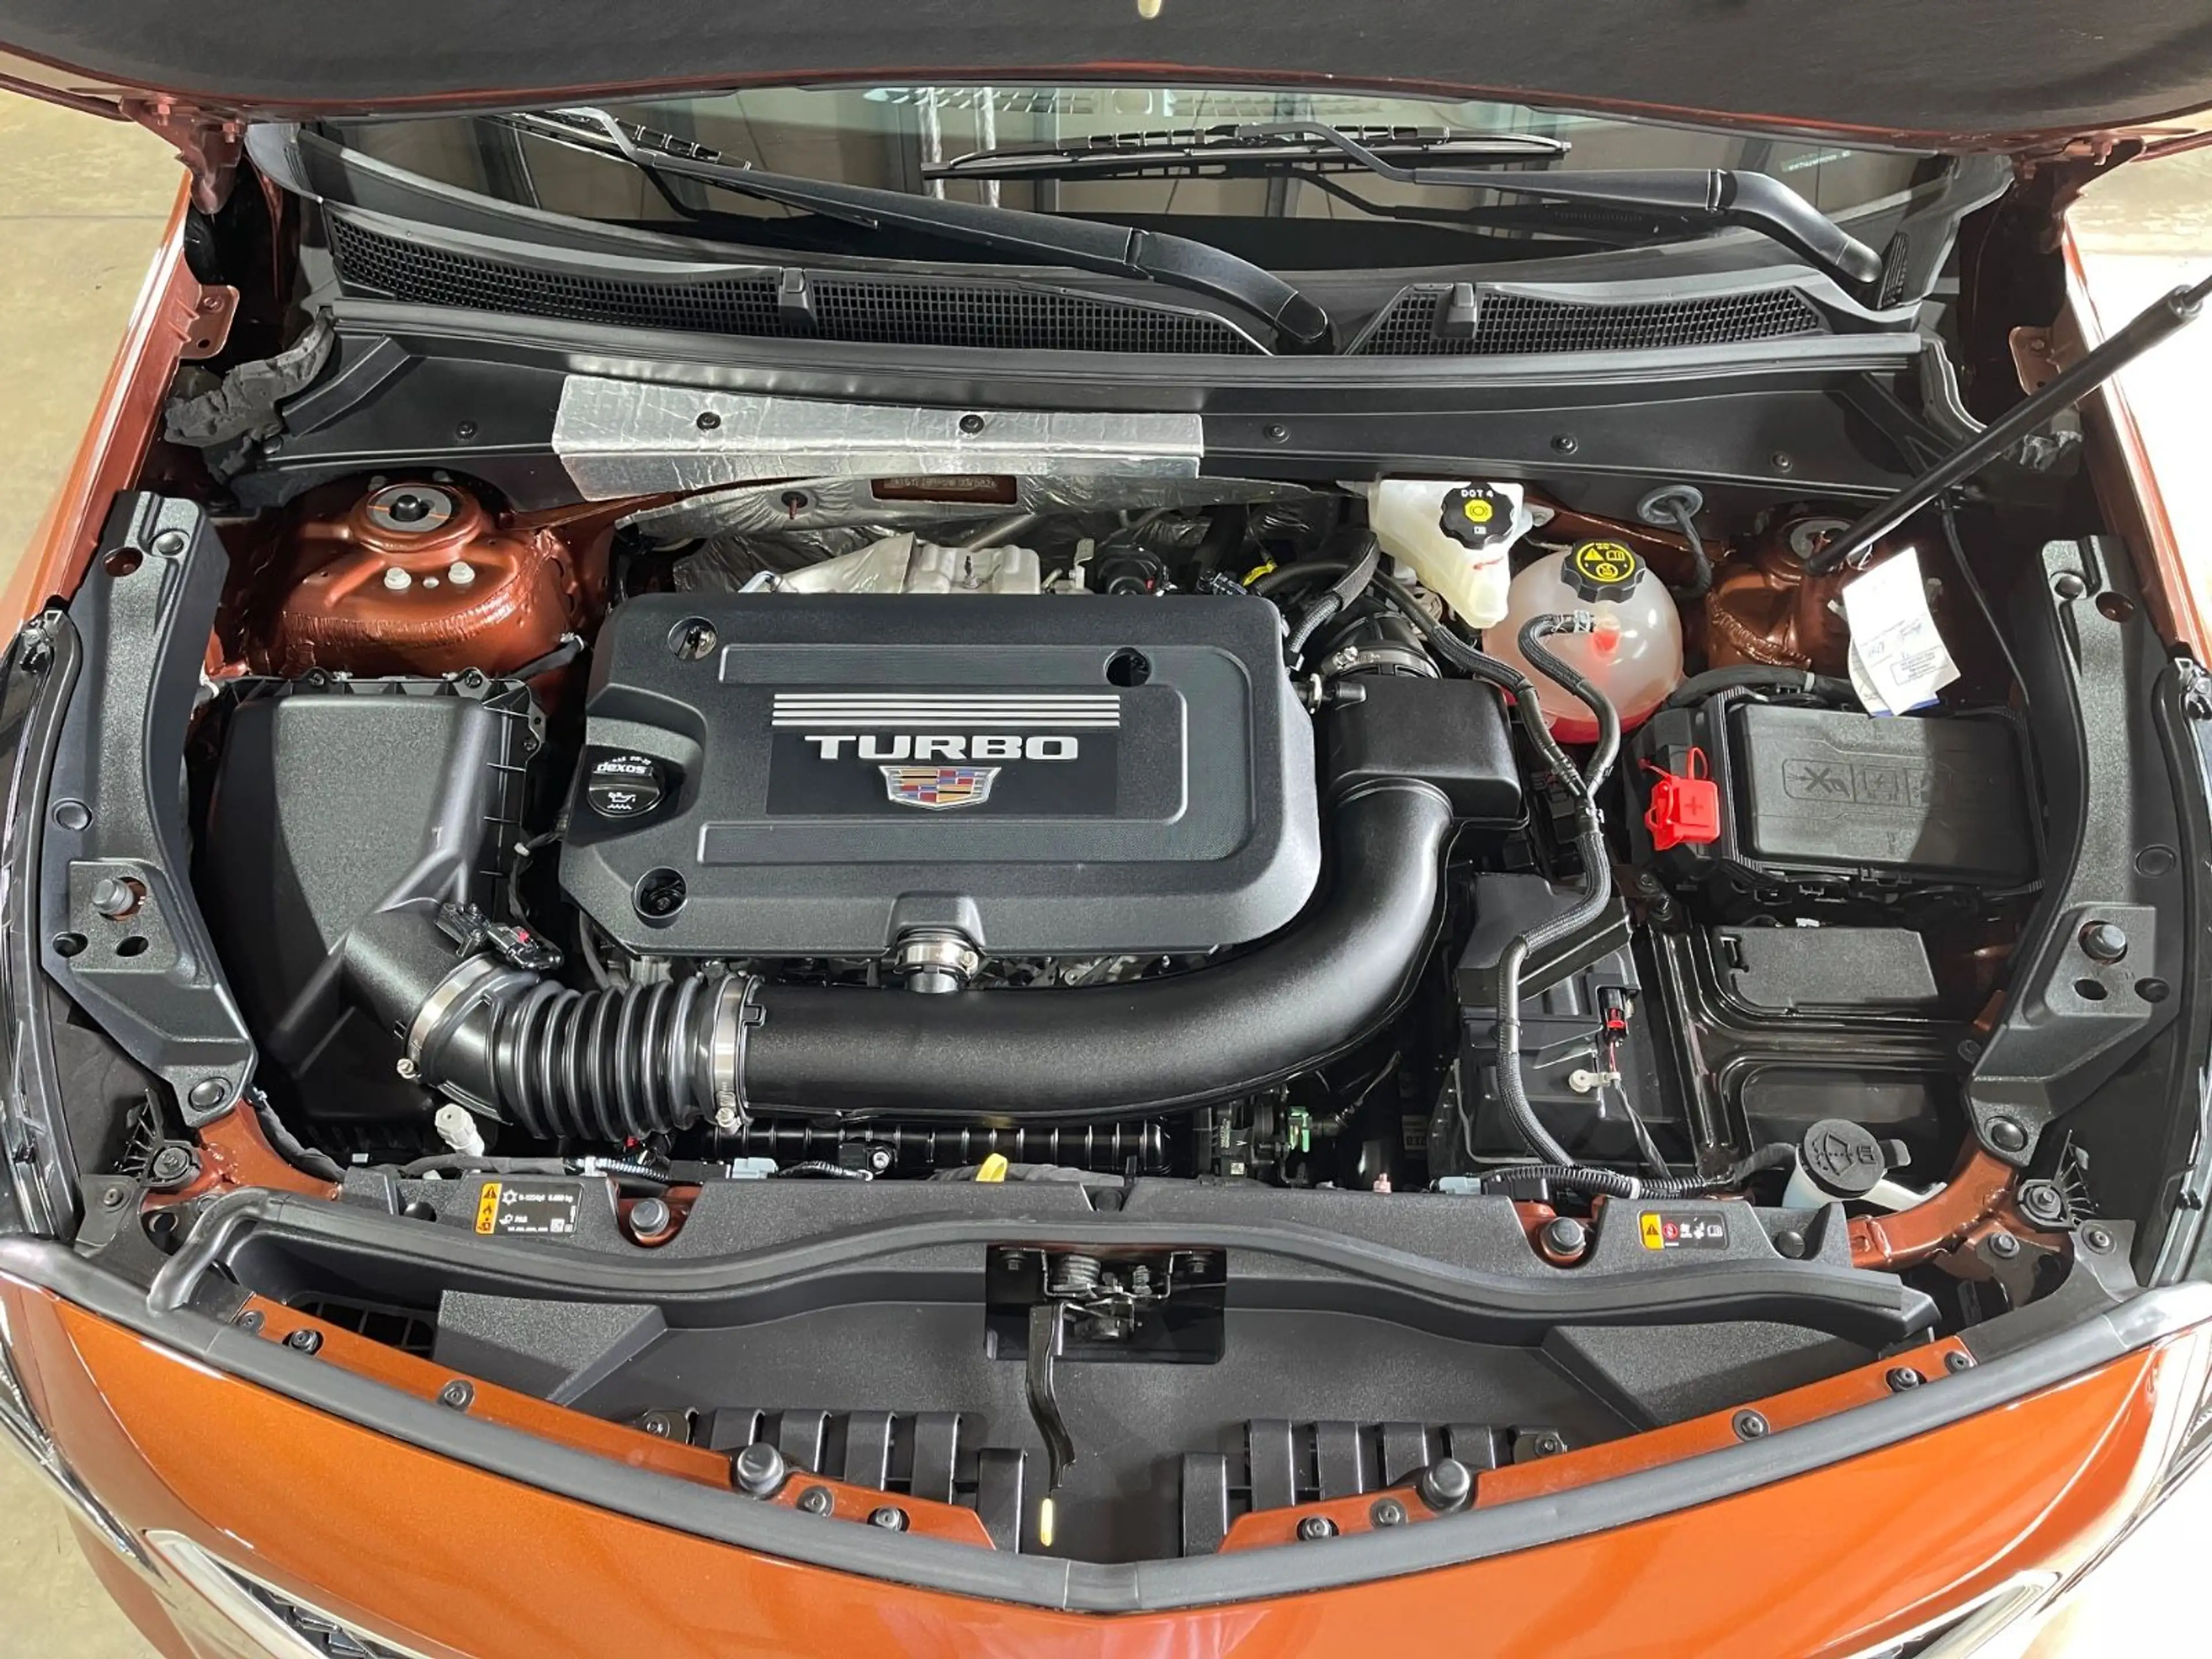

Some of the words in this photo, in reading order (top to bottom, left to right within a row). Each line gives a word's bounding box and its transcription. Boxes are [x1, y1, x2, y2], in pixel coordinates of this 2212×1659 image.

[1461, 489, 1483, 498] DOT
[1486, 490, 1494, 498] 4
[804, 735, 1079, 760] TURBO
[597, 762, 647, 774] dexos
